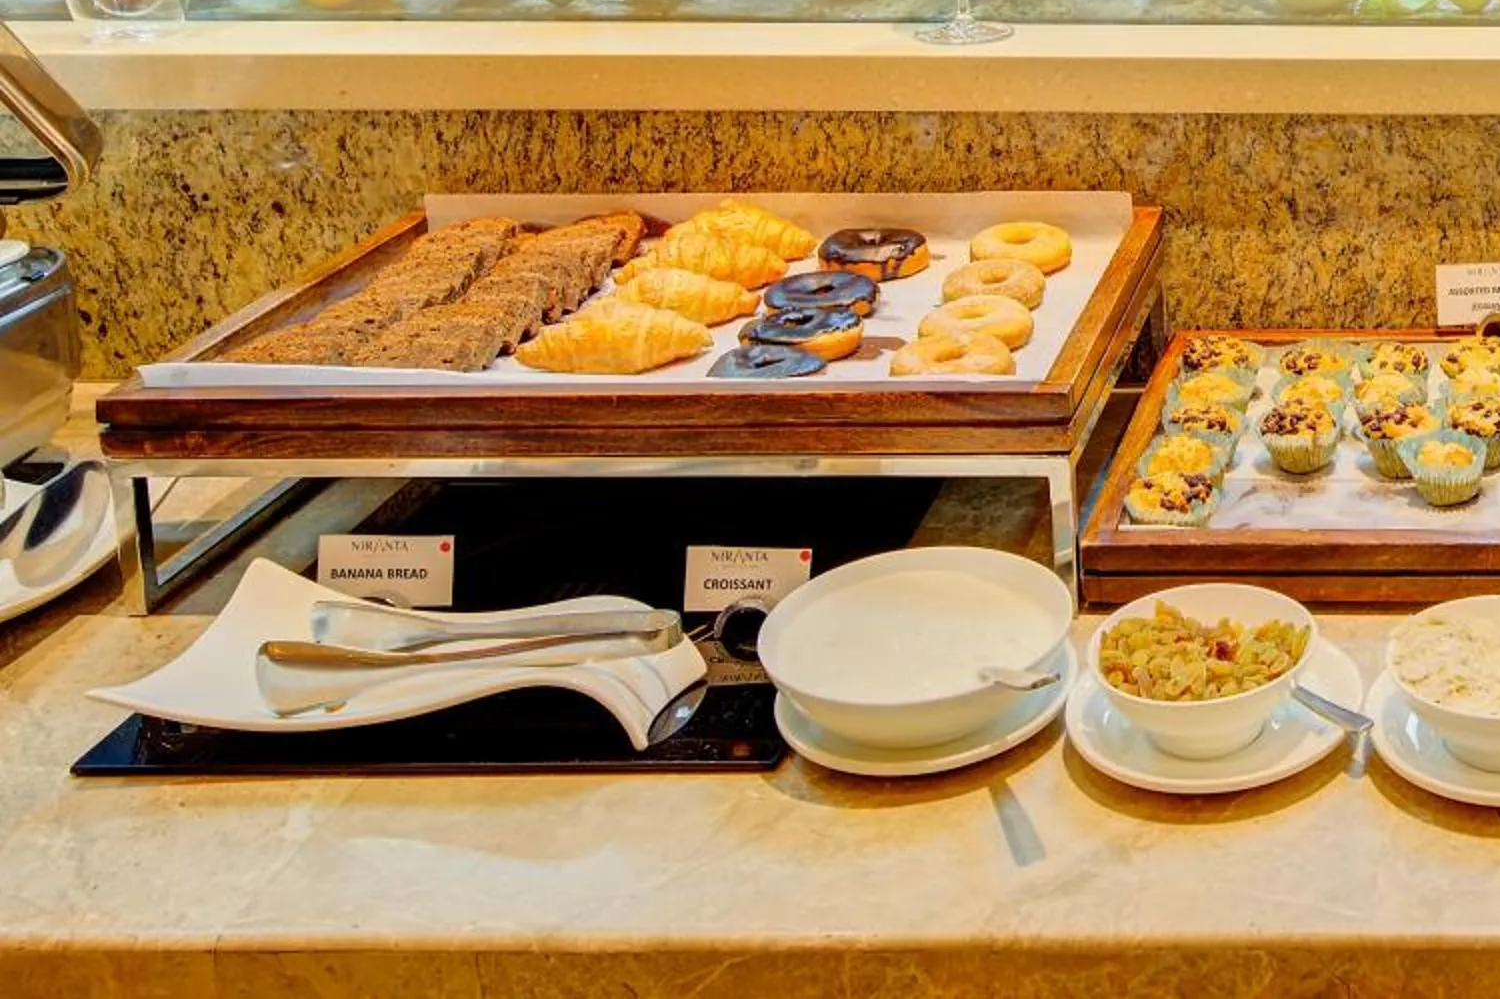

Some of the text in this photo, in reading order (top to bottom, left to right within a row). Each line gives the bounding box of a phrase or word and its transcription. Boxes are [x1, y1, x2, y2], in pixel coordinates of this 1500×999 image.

[330, 568, 428, 580] BANANA BREAD
[703, 578, 773, 590] CROISSANT
